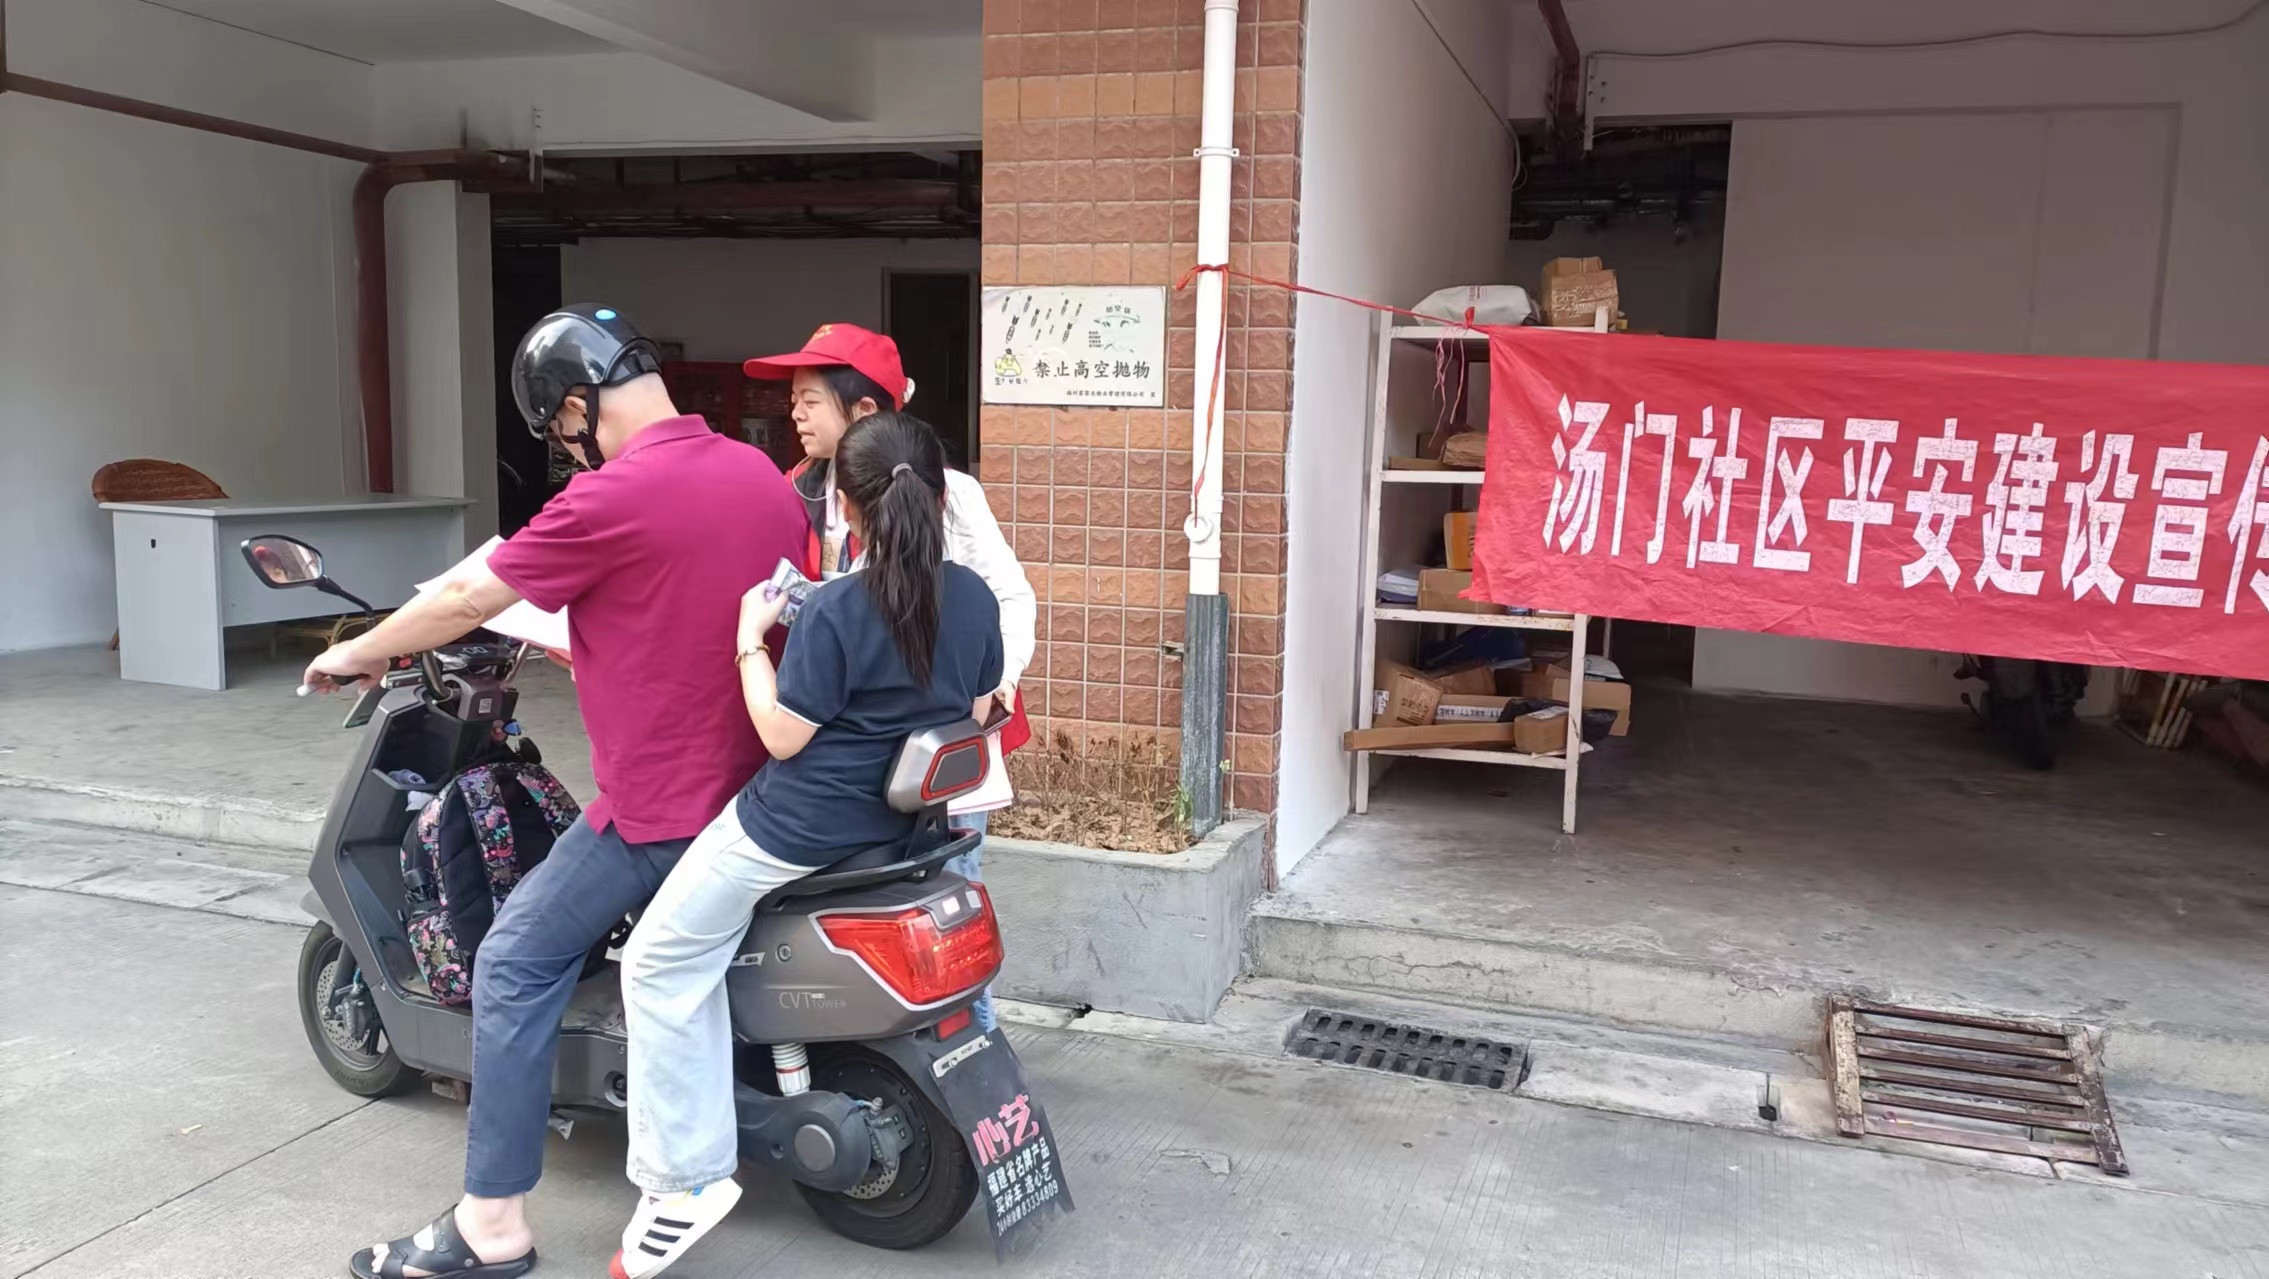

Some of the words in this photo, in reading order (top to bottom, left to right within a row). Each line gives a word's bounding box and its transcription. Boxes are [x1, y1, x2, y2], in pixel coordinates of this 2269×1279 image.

[1033, 360, 1150, 379] 禁止高空抛物
[779, 991, 811, 1009] CVT
[972, 1093, 1039, 1167] 心艺
[987, 1136, 1050, 1197] 福建省名牌产品
